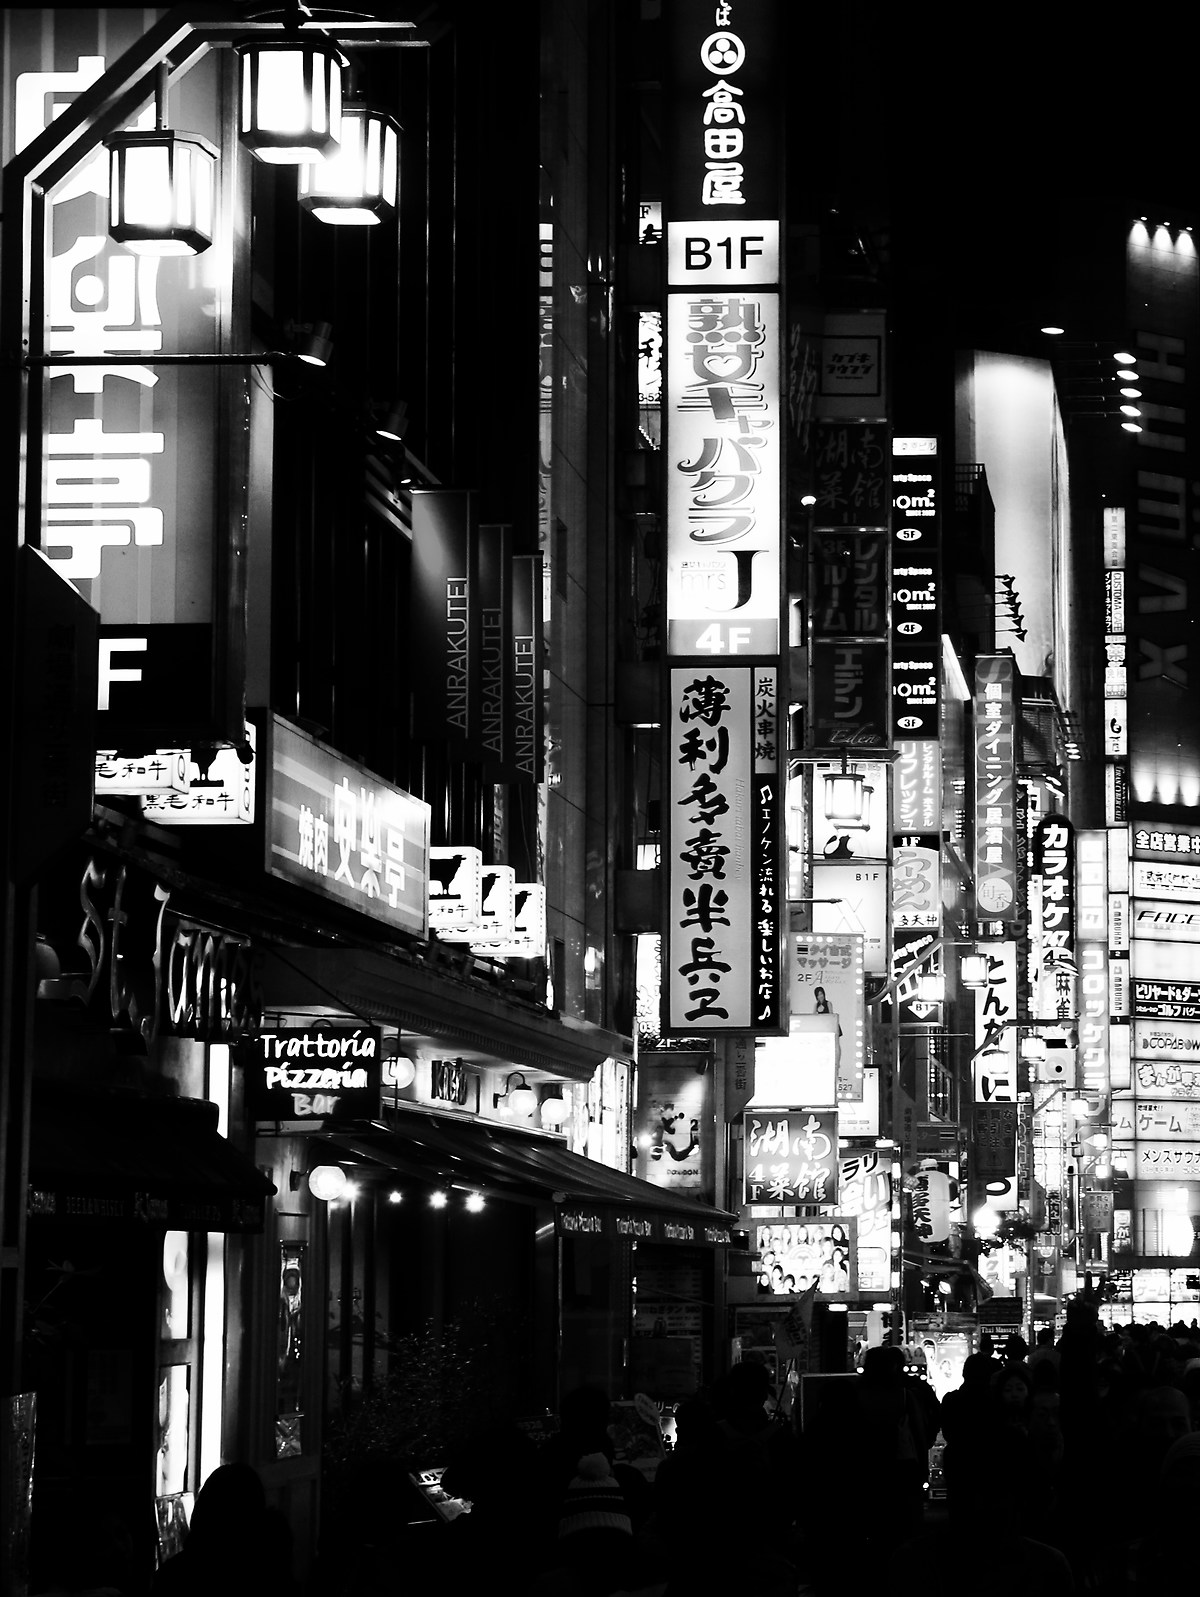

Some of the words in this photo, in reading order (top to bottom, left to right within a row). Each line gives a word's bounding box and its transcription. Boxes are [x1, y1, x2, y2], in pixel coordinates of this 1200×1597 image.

[714, 0, 731, 27] ば
[702, 79, 746, 206] 高田屋
[684, 237, 764, 270] B1F
[902, 528, 918, 540] 5F
[696, 623, 750, 654] 4F
[903, 622, 919, 634] 4F
[446, 577, 468, 729] ANRAKUTEI
[481, 608, 502, 753] ANRAKUTEI
[515, 634, 534, 775] ANRAKUTEI
[755, 677, 776, 761] 炭火串焼
[904, 716, 920, 728] 3F
[142, 793, 234, 812] 黒毛和牛
[900, 743, 918, 830] リフレッシュ
[902, 836, 921, 847] 1F
[854, 872, 880, 881] B1F
[1041, 823, 1070, 929] カラオケ
[1113, 911, 1122, 945] MARUHAN
[797, 973, 812, 982] 2F
[1114, 977, 1122, 1011] MARUHAN
[1055, 971, 1071, 1020] 麻雀
[1158, 1004, 1182, 1017] ゴルフ
[260, 1030, 376, 1059] Trattoria
[264, 1062, 368, 1089] Pizzeria
[750, 1114, 831, 1159] 湖南
[768, 1162, 831, 1203] 菜館
